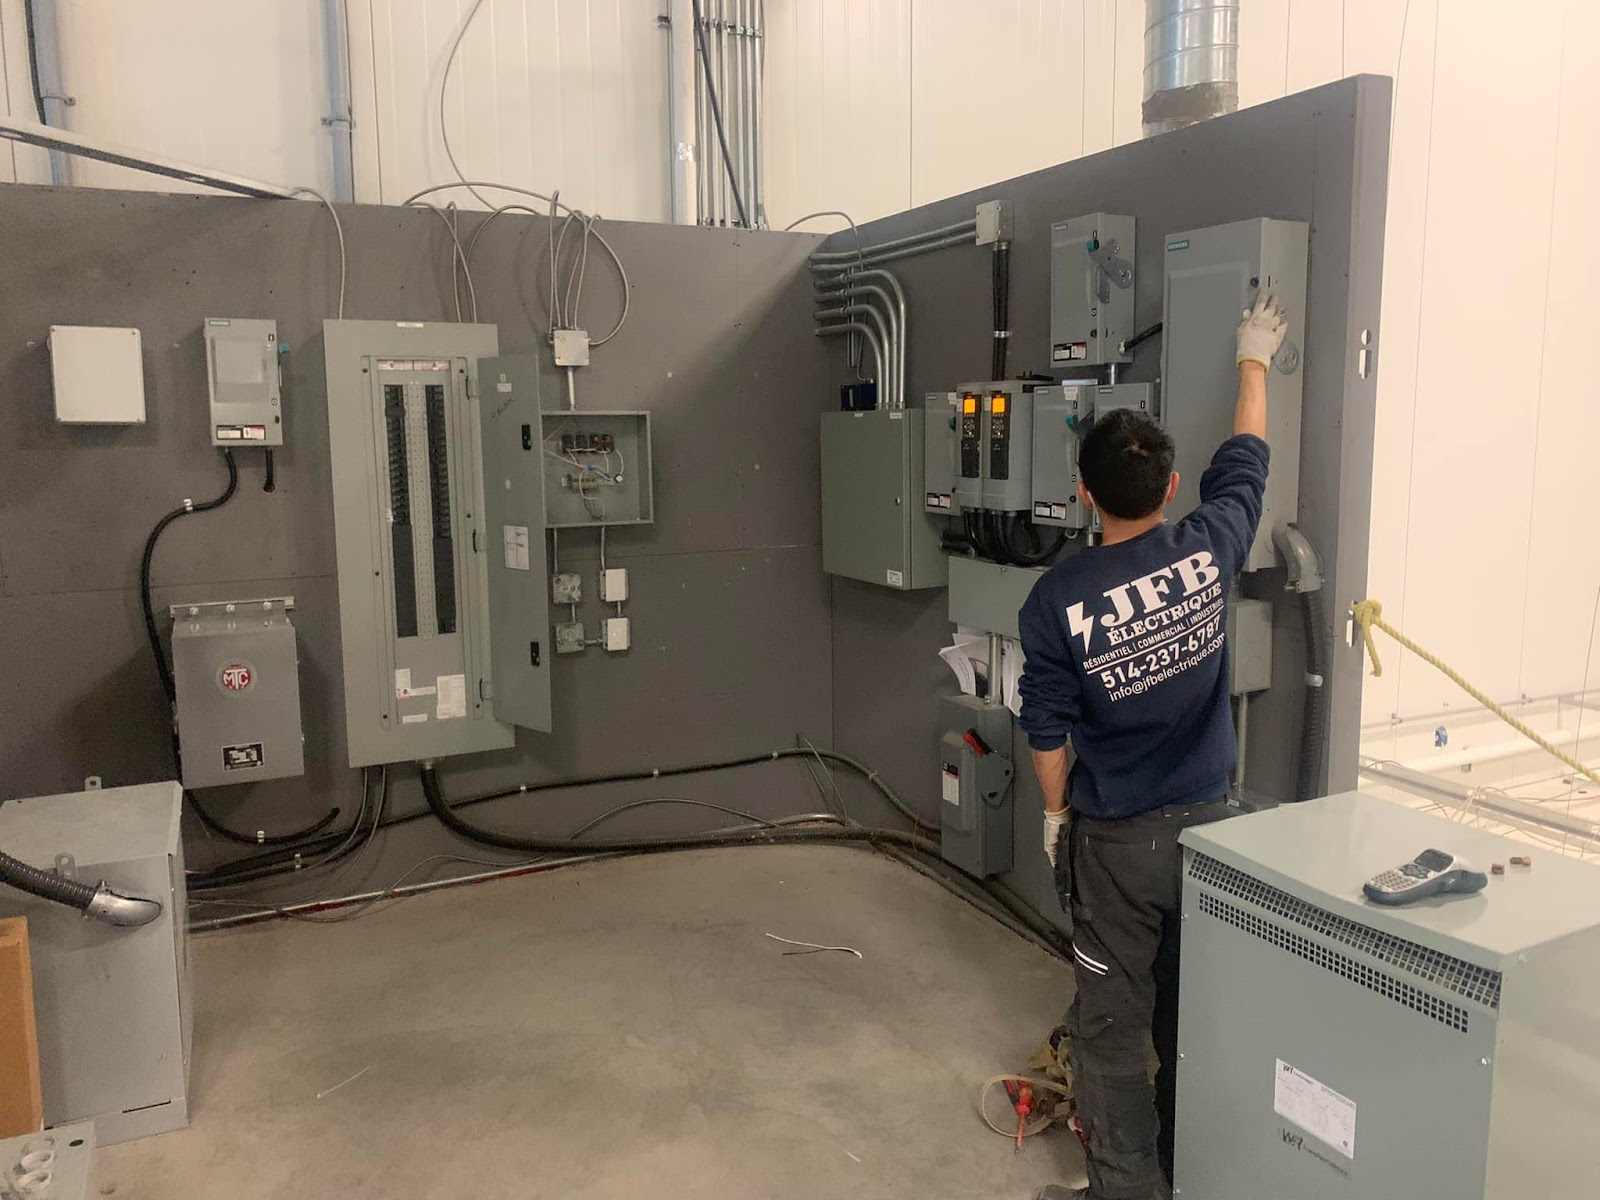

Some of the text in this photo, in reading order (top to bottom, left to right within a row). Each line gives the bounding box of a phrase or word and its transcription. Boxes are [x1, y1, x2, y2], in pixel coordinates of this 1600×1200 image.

[1100, 551, 1220, 627] JFB
[1106, 582, 1222, 646] ÉLECTRIQUE
[1083, 646, 1133, 669] RÉSIDENTIEL
[1138, 624, 1186, 648] COMMERCIAL
[1100, 614, 1221, 689] 514-237-6787
[223, 668, 249, 690] MTC
